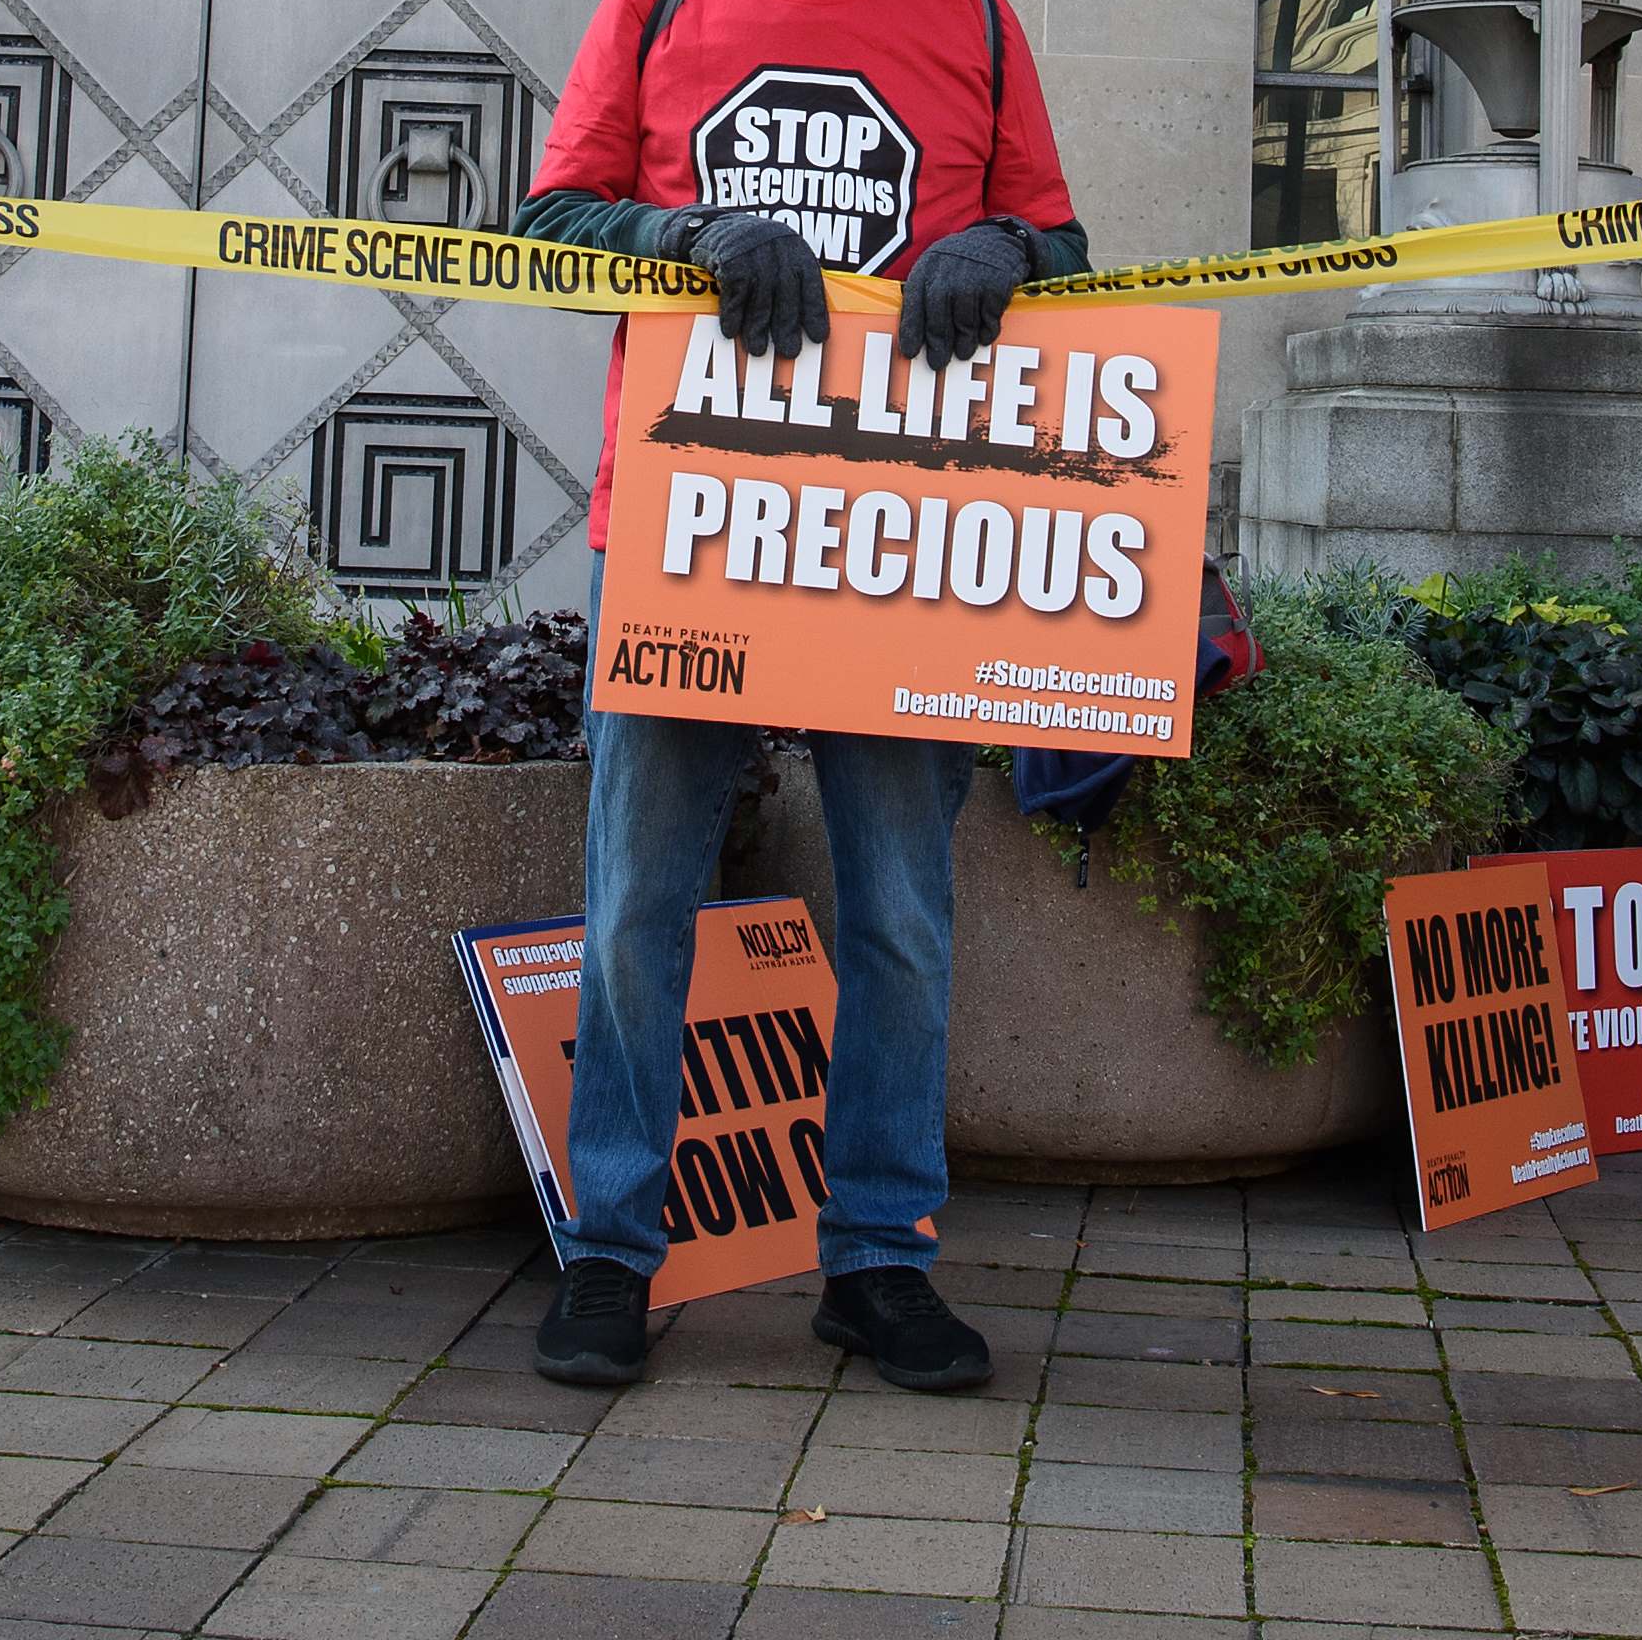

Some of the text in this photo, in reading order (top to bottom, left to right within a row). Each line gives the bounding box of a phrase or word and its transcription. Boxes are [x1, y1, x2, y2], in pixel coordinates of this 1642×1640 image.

[733, 105, 881, 170] STOP
[713, 166, 895, 217] EXECUTIONS
[219, 220, 338, 269] CRIME
[345, 228, 461, 286] SCENE
[469, 242, 519, 291] DO
[529, 246, 605, 295] NOT
[673, 315, 1158, 459] ALL LIFE IS
[662, 472, 1146, 620] PRECIOUS
[621, 623, 751, 646] DEATH PENALTY
[608, 638, 746, 696] ACTION
[974, 660, 1176, 701] #StopExecutions
[893, 688, 1174, 741] DeathPenaltyAction.org
[502, 969, 581, 996] Executions
[1405, 903, 1550, 1008] NO MORE
[1424, 1002, 1561, 1114] KILLING!
